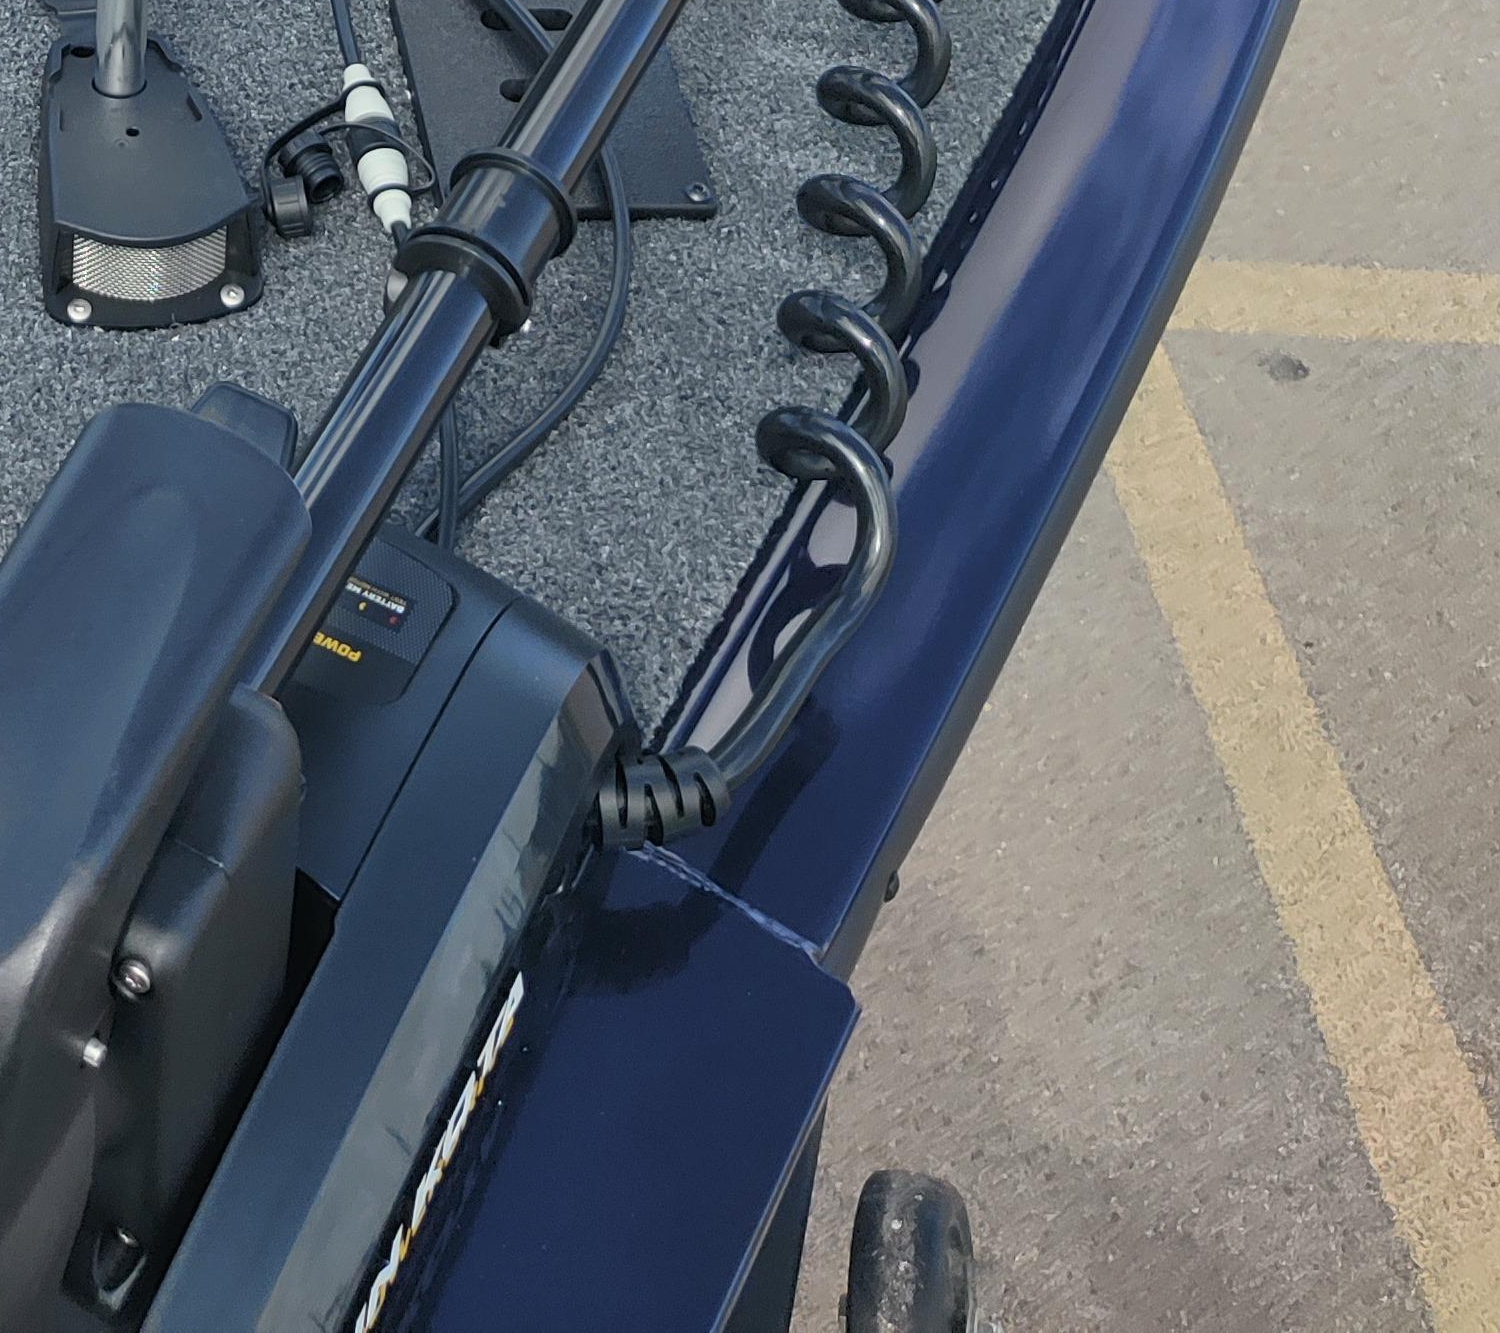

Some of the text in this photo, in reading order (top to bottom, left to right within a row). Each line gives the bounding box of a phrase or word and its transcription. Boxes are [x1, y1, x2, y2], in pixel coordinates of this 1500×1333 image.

[345, 582, 362, 595] ME
[361, 588, 406, 614] BATTERY
[313, 631, 362, 662] POWE
